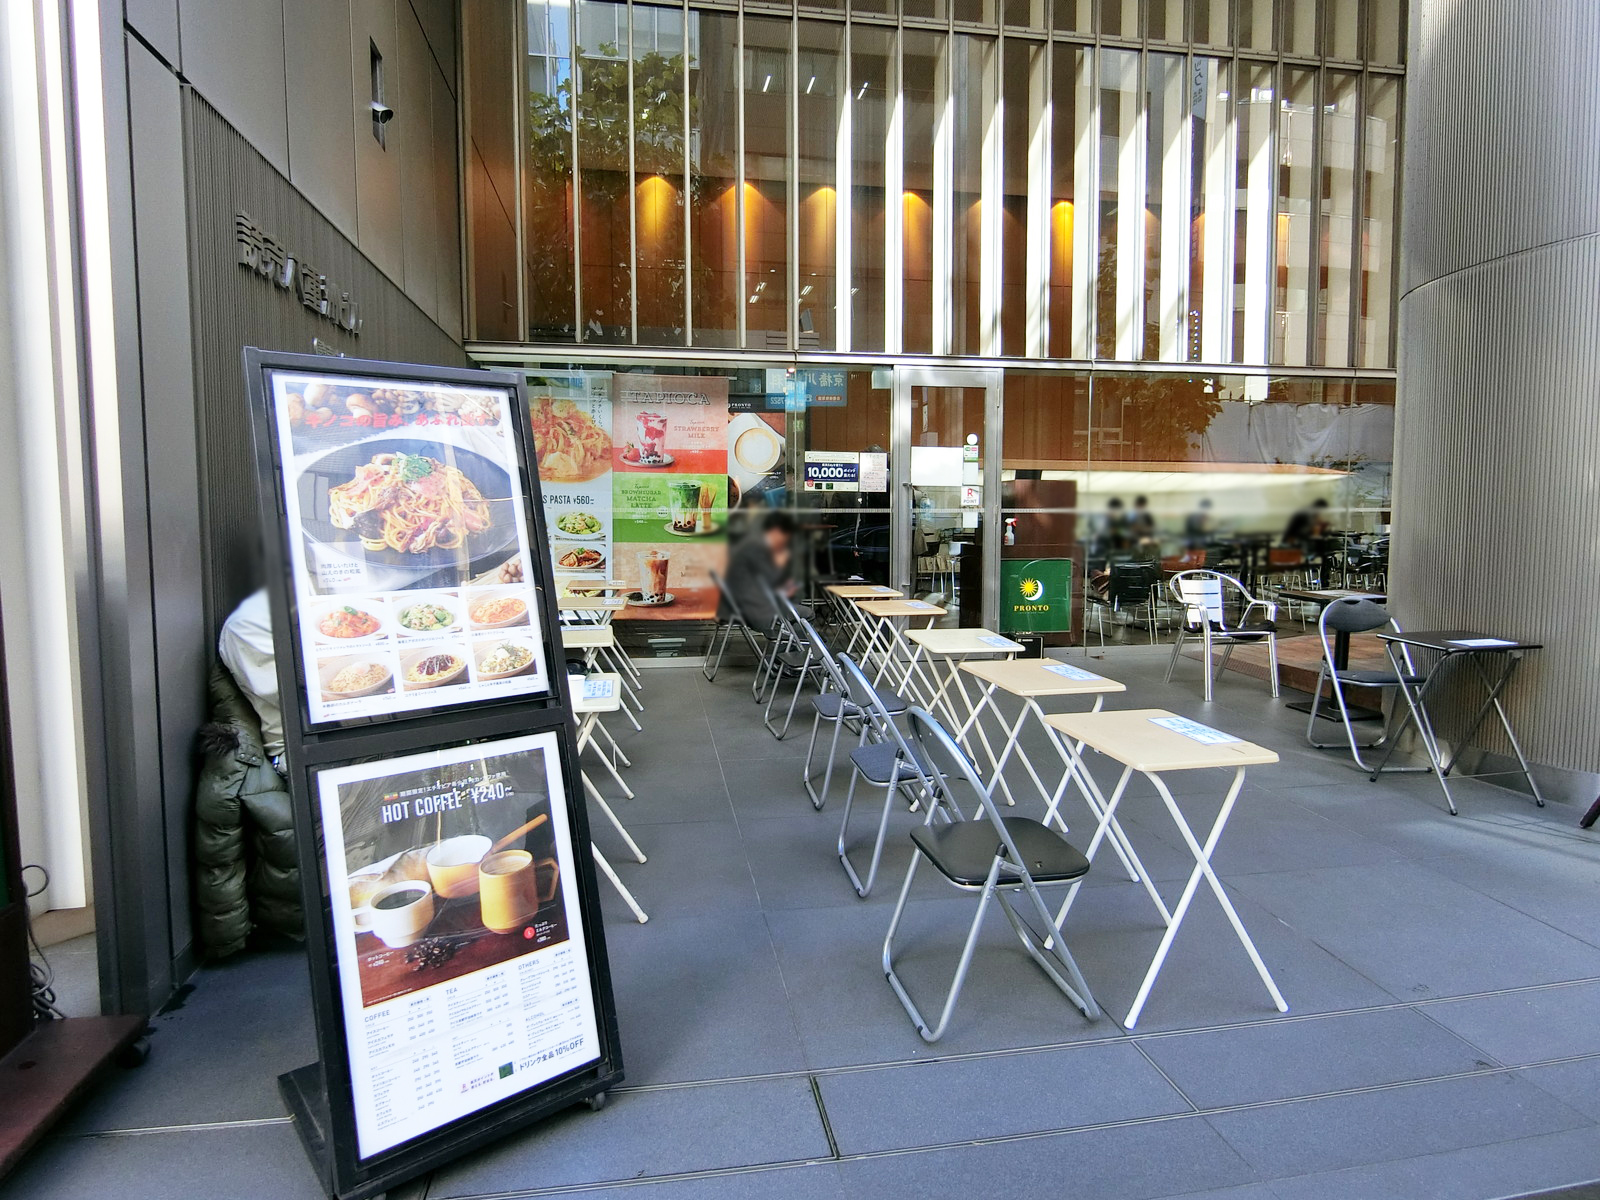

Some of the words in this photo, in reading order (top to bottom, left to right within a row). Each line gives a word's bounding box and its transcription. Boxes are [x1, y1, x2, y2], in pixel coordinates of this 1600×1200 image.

[630, 391, 710, 405] TAPIOCA
[808, 466, 844, 478] 10,000
[550, 494, 571, 504] PASTA
[1014, 604, 1050, 612] PRONTO
[381, 802, 411, 823] HOT
[414, 791, 462, 816] COFFEE
[518, 960, 539, 969] OTHERS
[364, 1010, 390, 1022] COFFEE
[519, 1051, 554, 1070] ドリンク全品
[555, 1038, 584, 1056] 10%OFF
